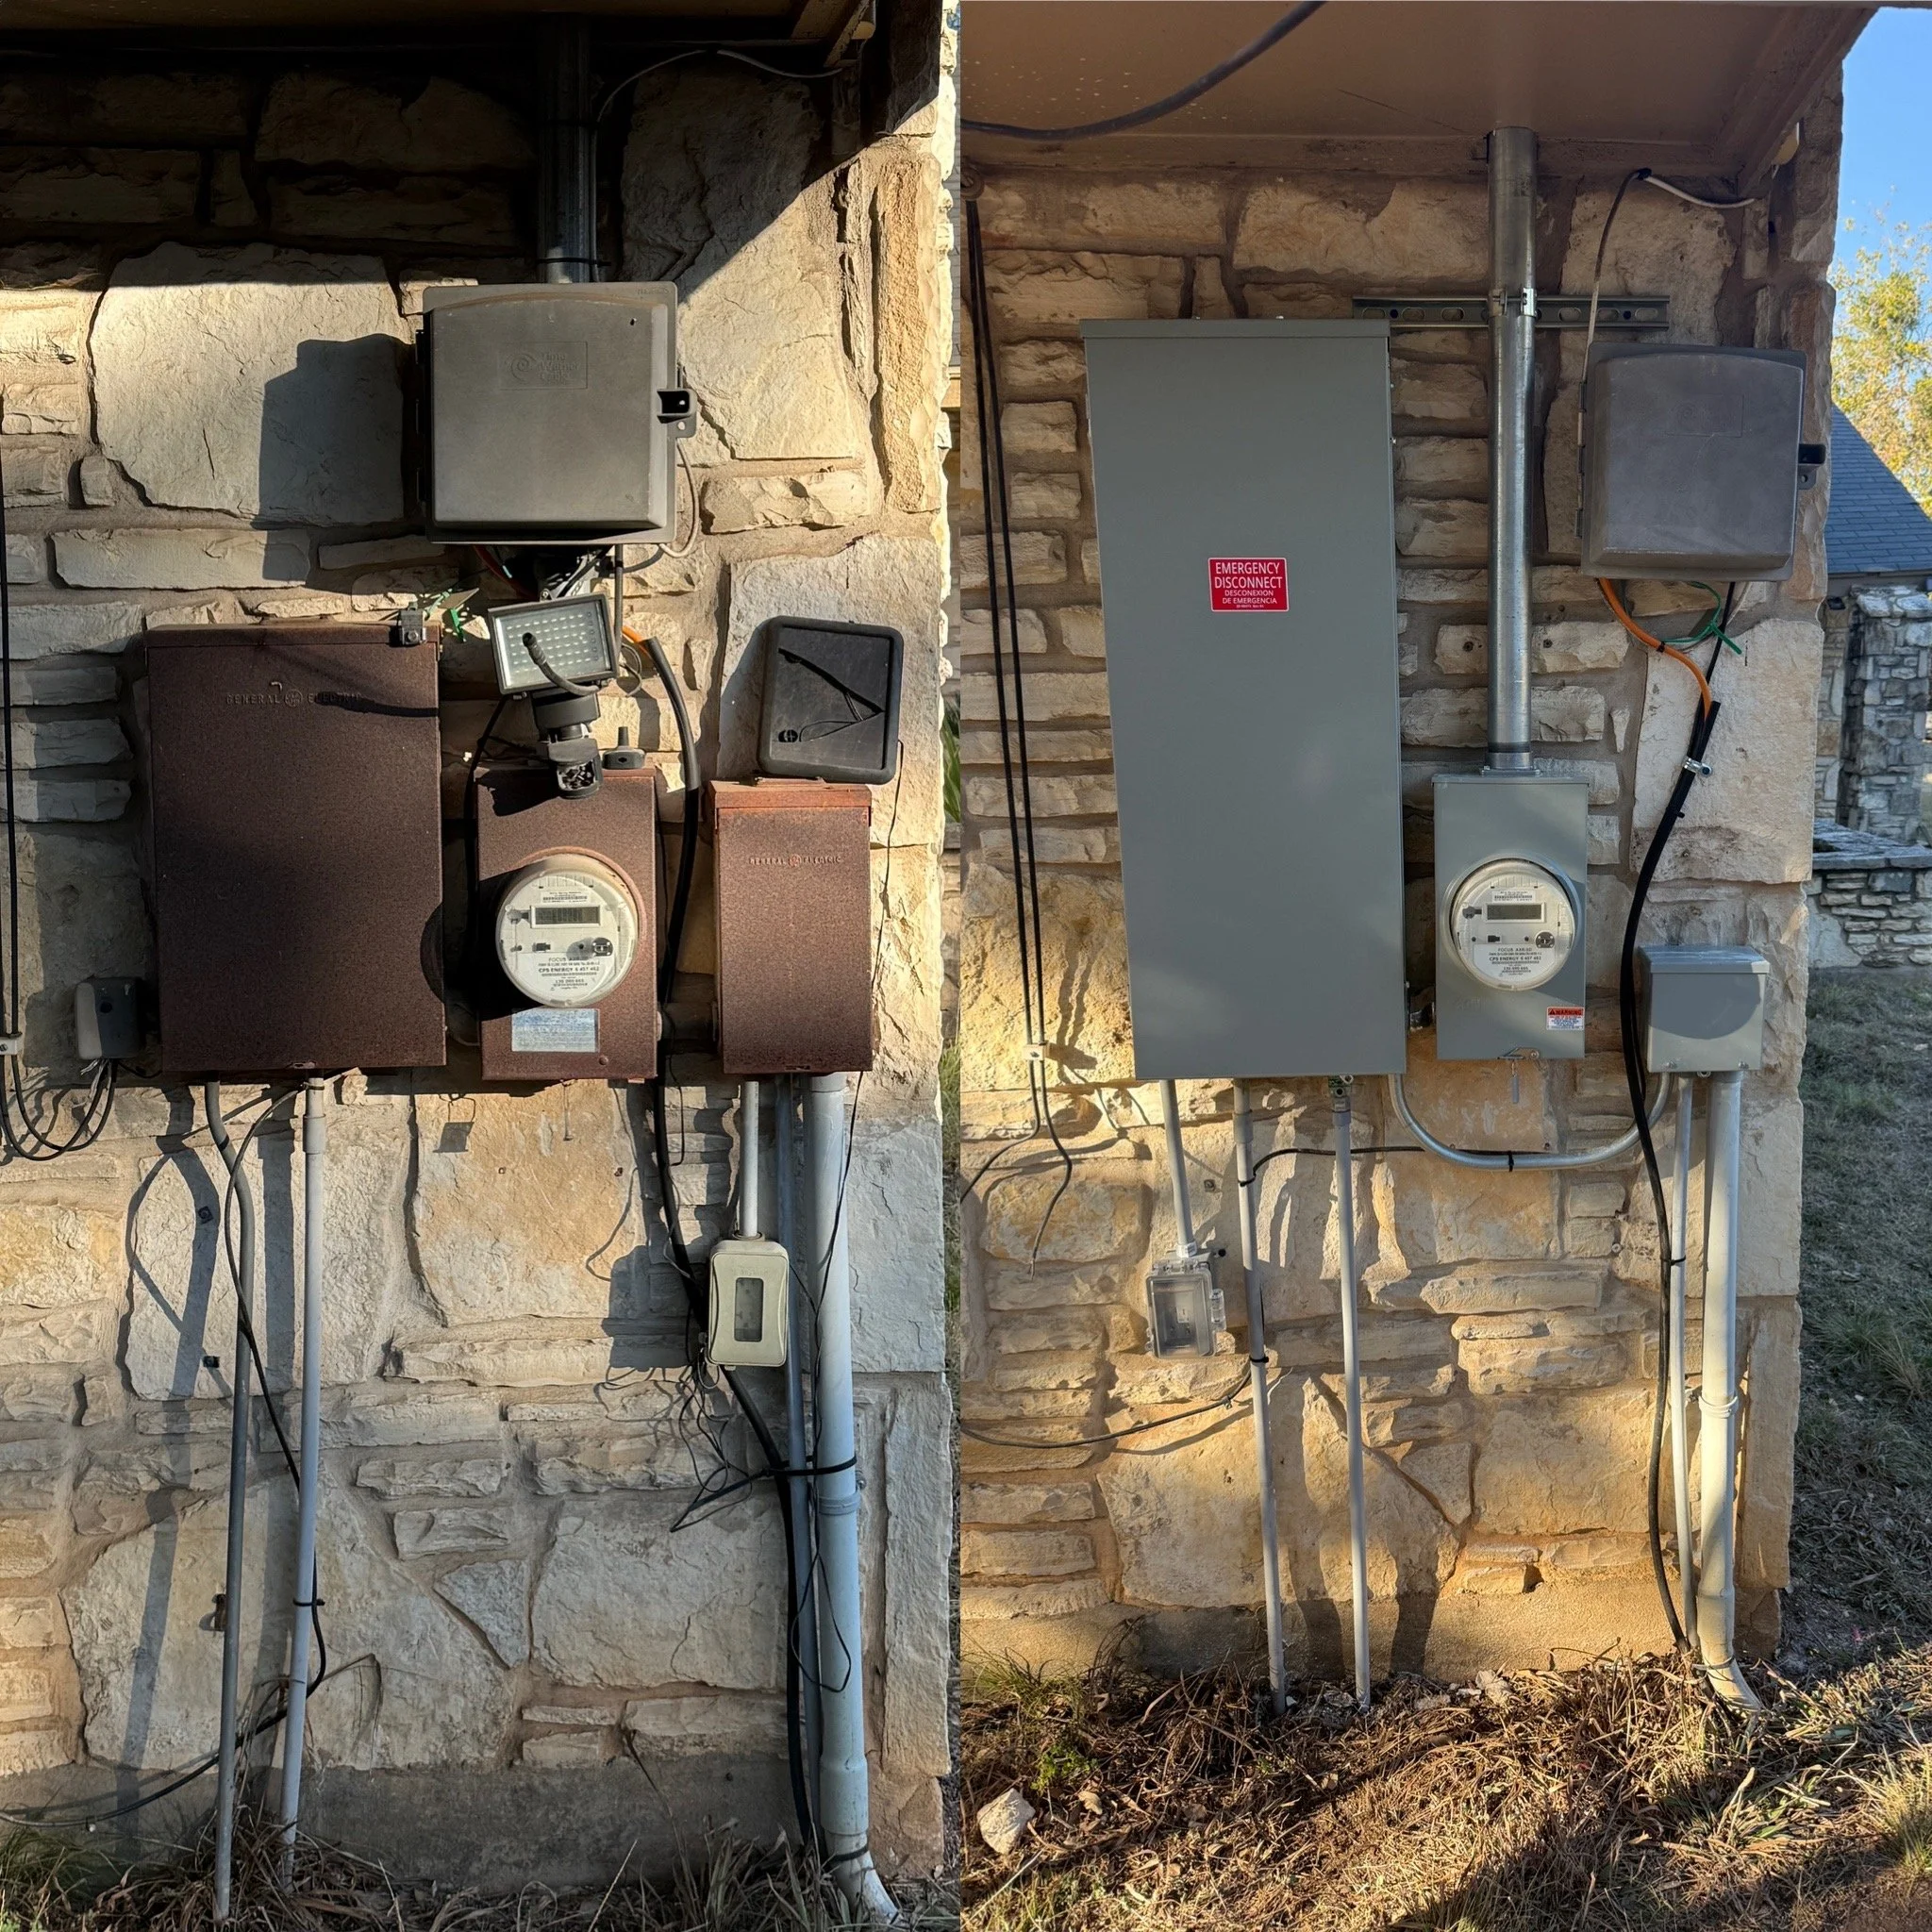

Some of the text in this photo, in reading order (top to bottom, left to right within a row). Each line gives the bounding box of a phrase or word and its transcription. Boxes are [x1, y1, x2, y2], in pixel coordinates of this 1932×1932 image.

[1215, 562, 1280, 575] EMERGENCY
[1214, 576, 1283, 589] DISCONNECT
[226, 693, 280, 705] GENERAL
